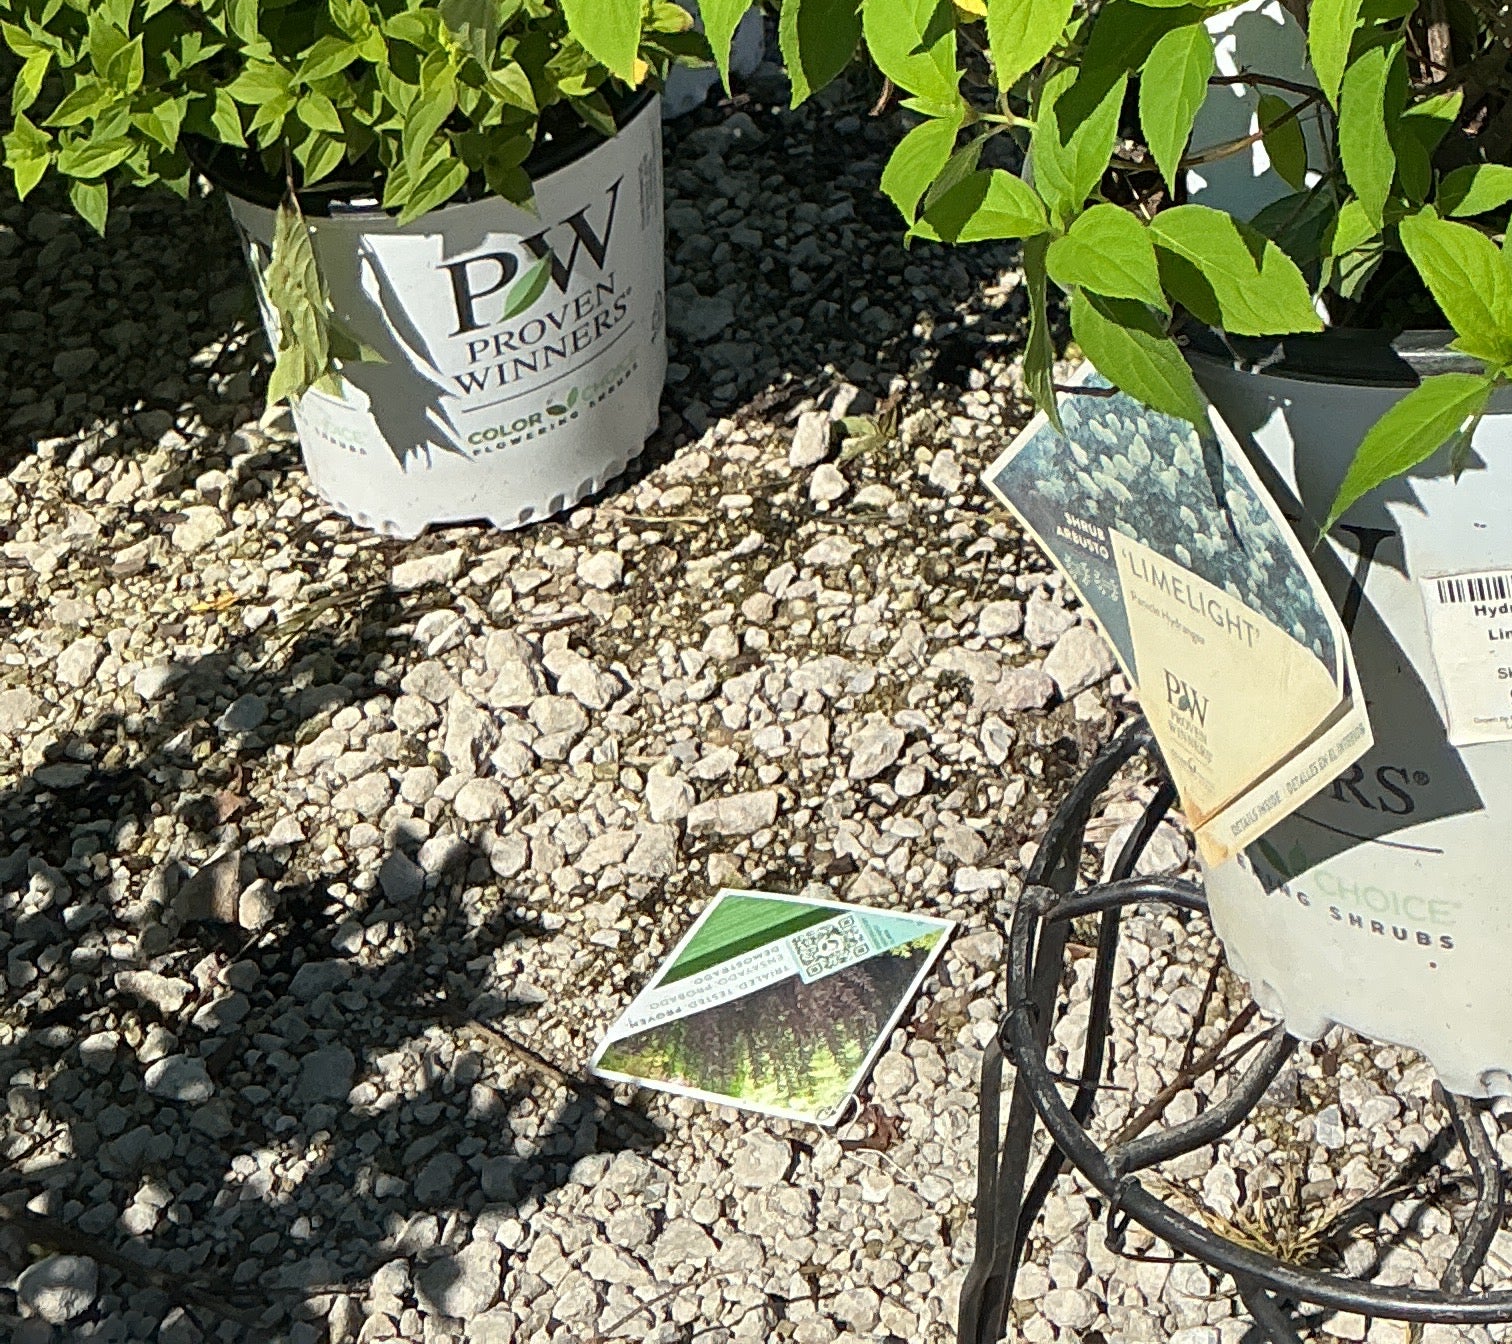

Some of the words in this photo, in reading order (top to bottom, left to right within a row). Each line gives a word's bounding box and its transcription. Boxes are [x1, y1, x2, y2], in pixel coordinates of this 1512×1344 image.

[435, 173, 625, 339] PW
[452, 292, 628, 395] WINNERS
[466, 271, 616, 365] PROVEN
[467, 412, 543, 446] COLOR
[1056, 525, 1111, 560] ARBUSTO
[1064, 511, 1106, 542] SHRUB
[1163, 668, 1210, 728] PW
[1313, 868, 1463, 926] CHOICE
[1329, 905, 1455, 950] SHRUBS
